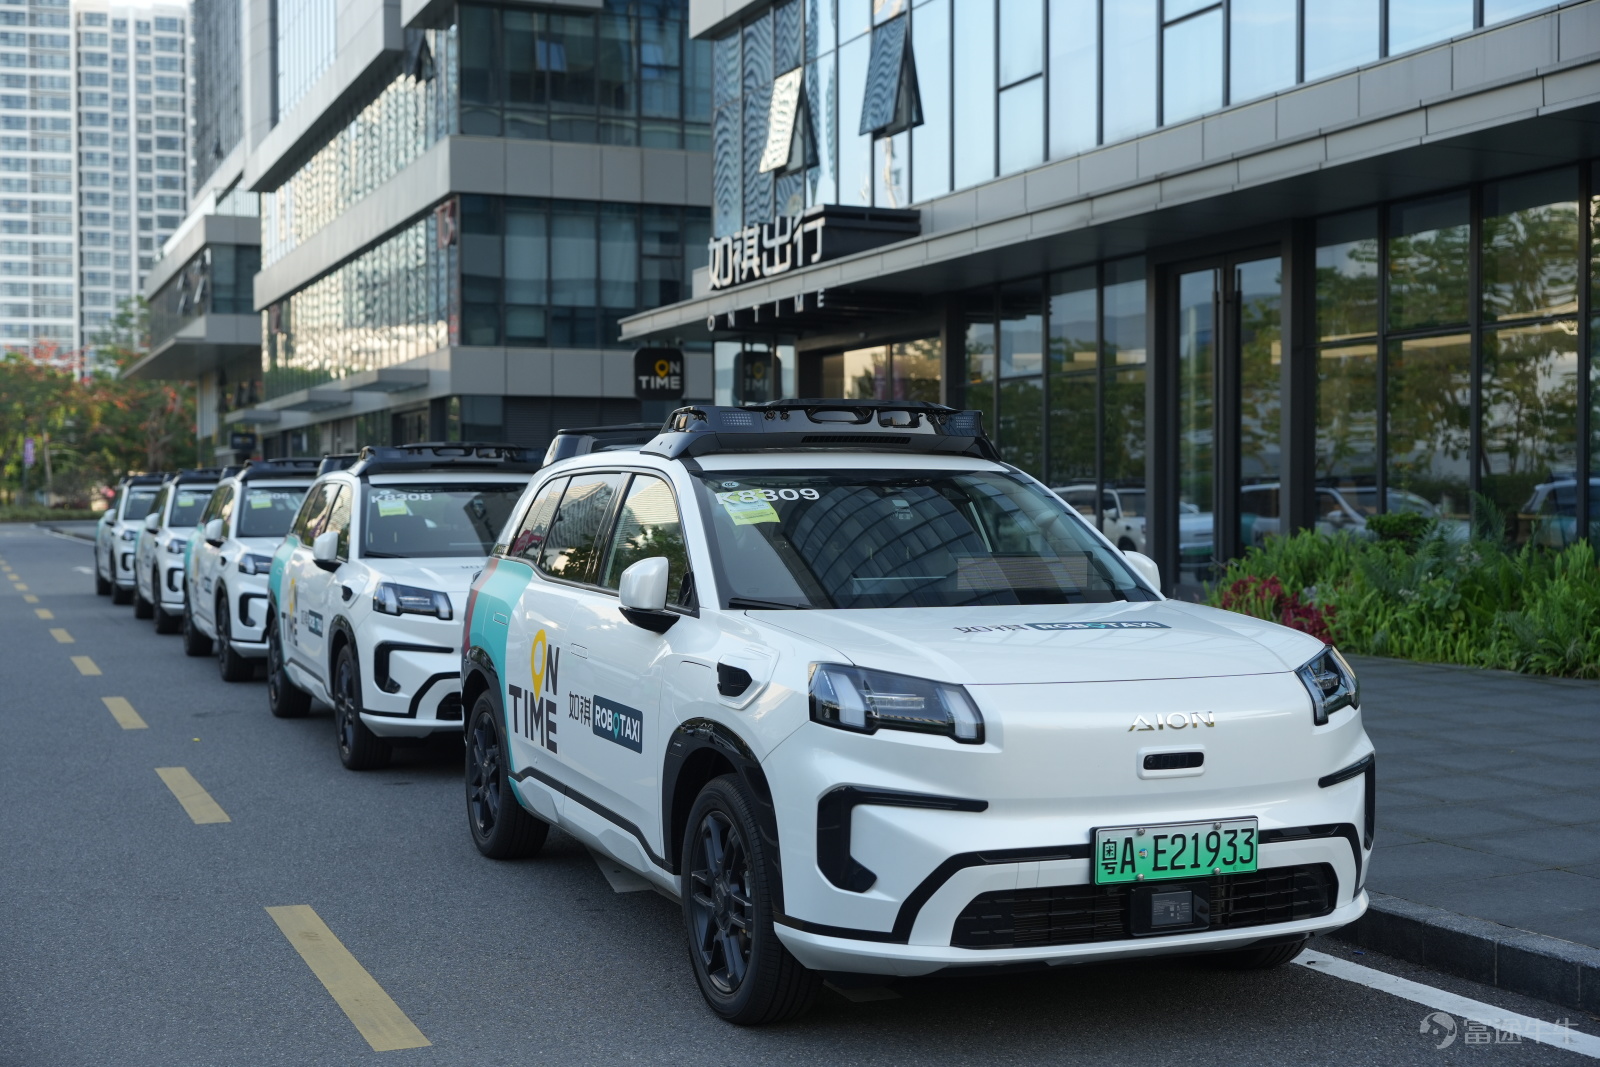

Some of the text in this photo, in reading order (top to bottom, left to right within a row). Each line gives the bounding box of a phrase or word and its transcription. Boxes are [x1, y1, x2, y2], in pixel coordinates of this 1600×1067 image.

[708, 210, 826, 290] 如祺出行
[655, 360, 681, 379] ON
[638, 376, 681, 390] TIME
[371, 493, 433, 504] K8308
[715, 488, 820, 504] K8309
[1035, 621, 1162, 630] ROBOTAXI
[530, 629, 560, 703] ON
[509, 684, 558, 755] TIME
[569, 691, 641, 743] 如祺 ROBOTAXI
[1128, 711, 1215, 732] AION
[1152, 827, 1255, 872] E21933
